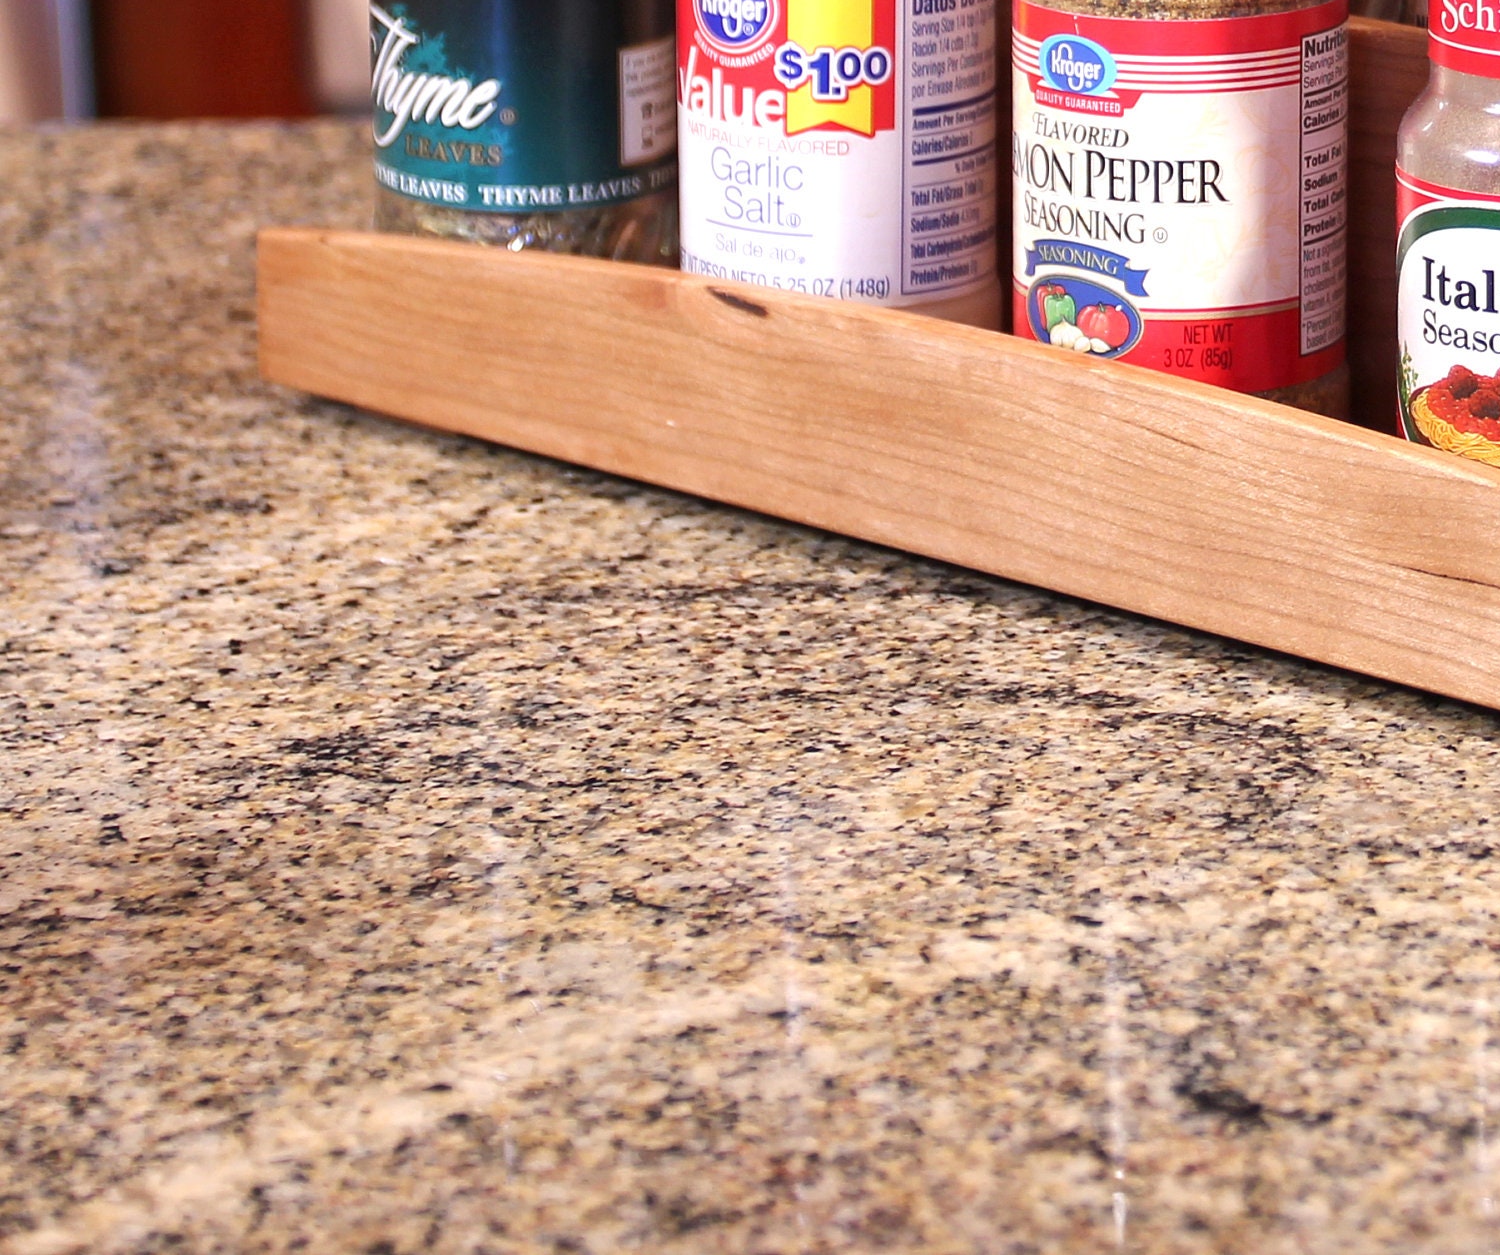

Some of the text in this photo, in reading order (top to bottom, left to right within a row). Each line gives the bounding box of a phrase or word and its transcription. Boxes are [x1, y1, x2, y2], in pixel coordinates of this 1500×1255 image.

[912, 19, 940, 39] Serving
[941, 17, 955, 34] Size
[718, 43, 775, 68] GUARANTEED
[912, 57, 959, 79] Servings Per
[1050, 43, 1102, 89] Kroger
[370, 3, 502, 147] Thyme
[779, 48, 888, 96] $1.00
[678, 45, 786, 128] Value
[911, 84, 925, 101] por
[1035, 89, 1121, 114] QUALITY GUARANTEED
[1304, 92, 1333, 110] Amount
[912, 116, 942, 132] Amount
[1032, 111, 1130, 148] FLAVORED
[1303, 107, 1340, 129] Calories
[405, 133, 504, 167] LEAVES
[687, 119, 850, 156] NATURALLY FLAVORED
[711, 146, 804, 192] Garlic
[1304, 149, 1330, 169] Total
[1083, 149, 1230, 204] PEPPER
[1303, 171, 1338, 192] Sodium
[399, 174, 642, 206] LEAVES THYME LEAVES
[911, 191, 930, 207] Total
[724, 185, 784, 227] Salt
[1024, 190, 1146, 244] SEASONING
[1303, 194, 1329, 214] Total
[1303, 216, 1337, 237] Protein
[715, 232, 738, 255] Sal
[742, 240, 764, 258] de
[1303, 248, 1316, 263] Not
[1037, 244, 1119, 276] SEASONING
[812, 278, 835, 299] OZ
[839, 275, 890, 301] (148g)
[1184, 323, 1234, 344] NET WT
[1163, 346, 1234, 372] 3 OZ (85g)
